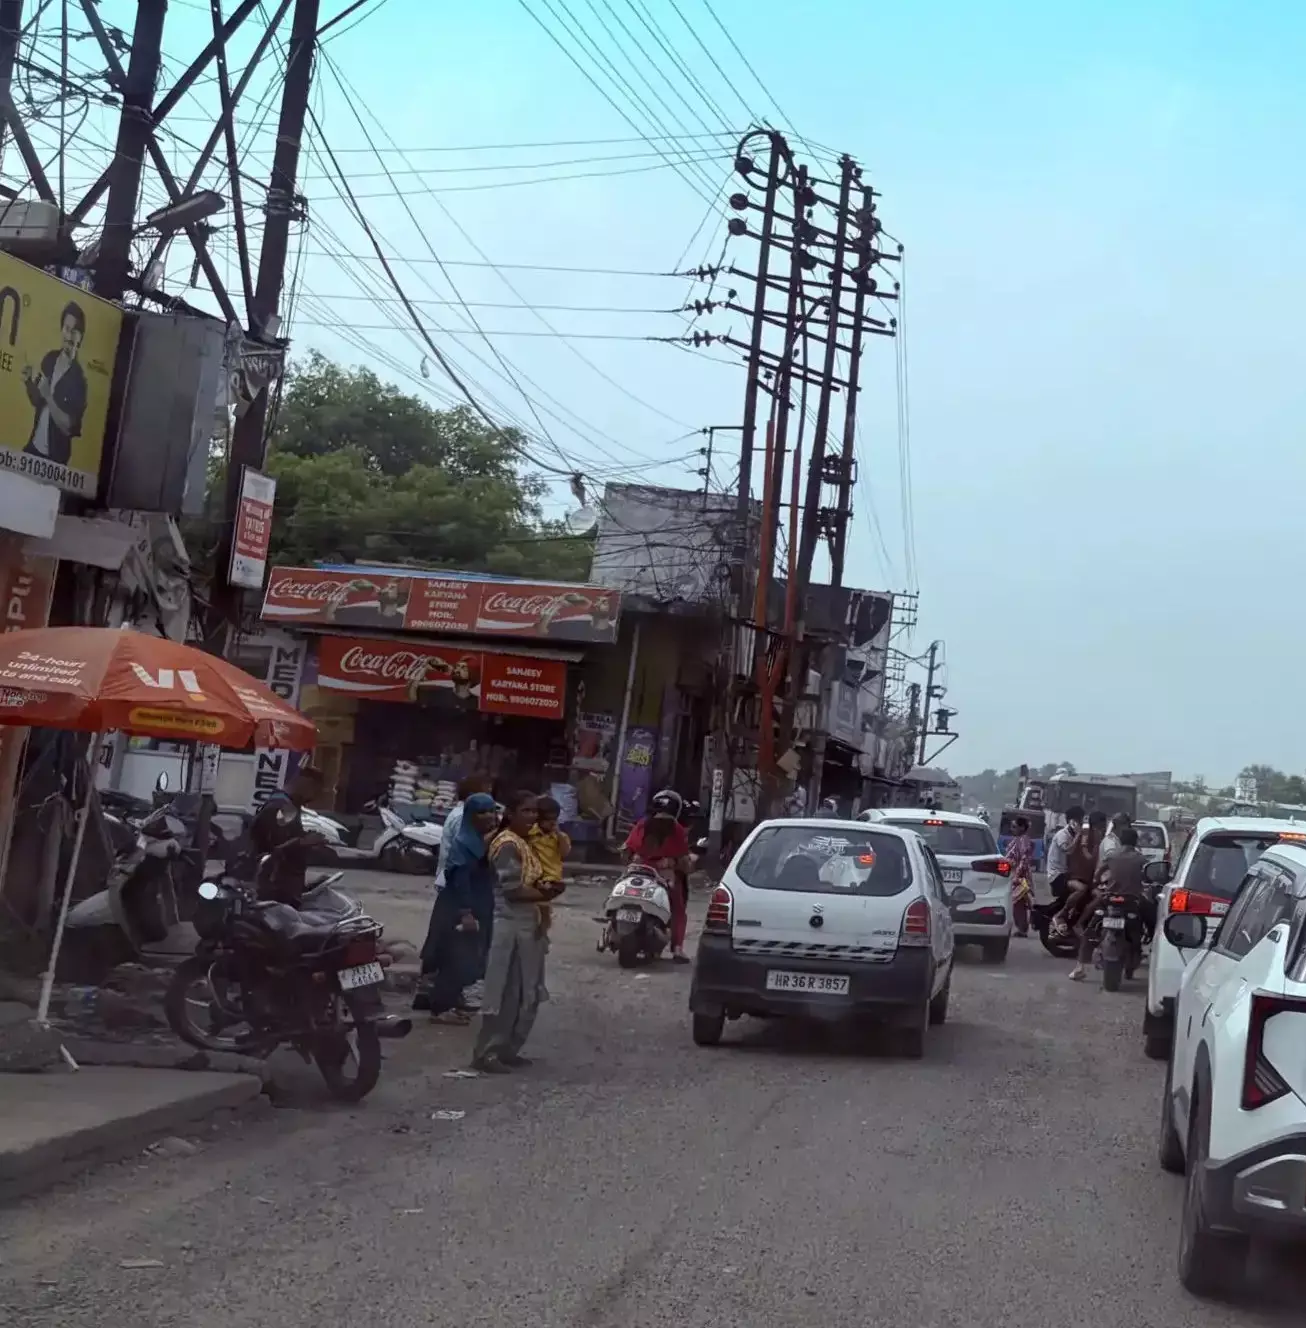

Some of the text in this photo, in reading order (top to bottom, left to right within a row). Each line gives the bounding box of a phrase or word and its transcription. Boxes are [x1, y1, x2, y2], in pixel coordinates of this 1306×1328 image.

[8, 660, 80, 677] unlimited
[18, 672, 50, 682] and
[775, 974, 847, 990] HR 36 R 3857
